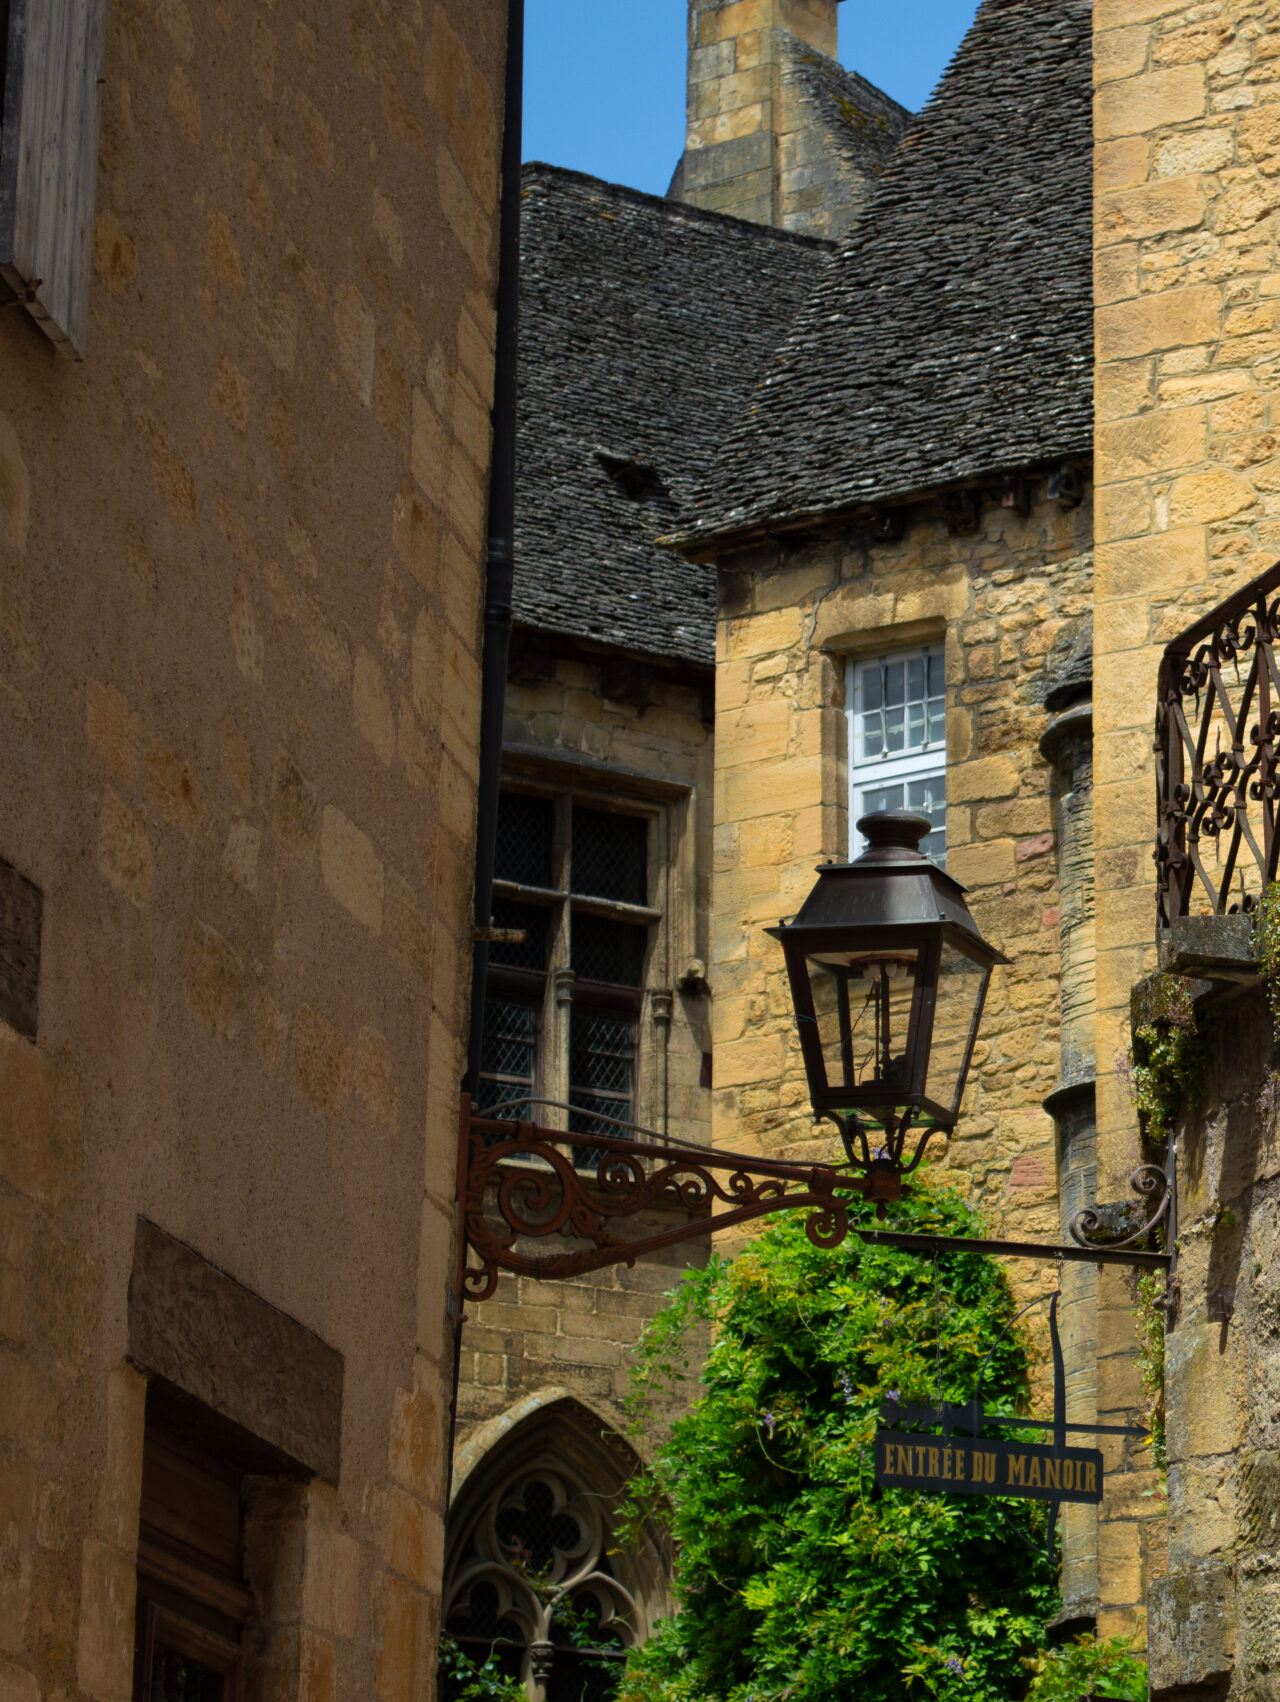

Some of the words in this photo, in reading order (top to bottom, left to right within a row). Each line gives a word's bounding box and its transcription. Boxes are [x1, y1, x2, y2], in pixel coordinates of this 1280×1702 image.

[882, 1443, 965, 1480] ENTRÉE
[971, 1451, 998, 1484] DU
[1006, 1453, 1097, 1493] MANOIR
